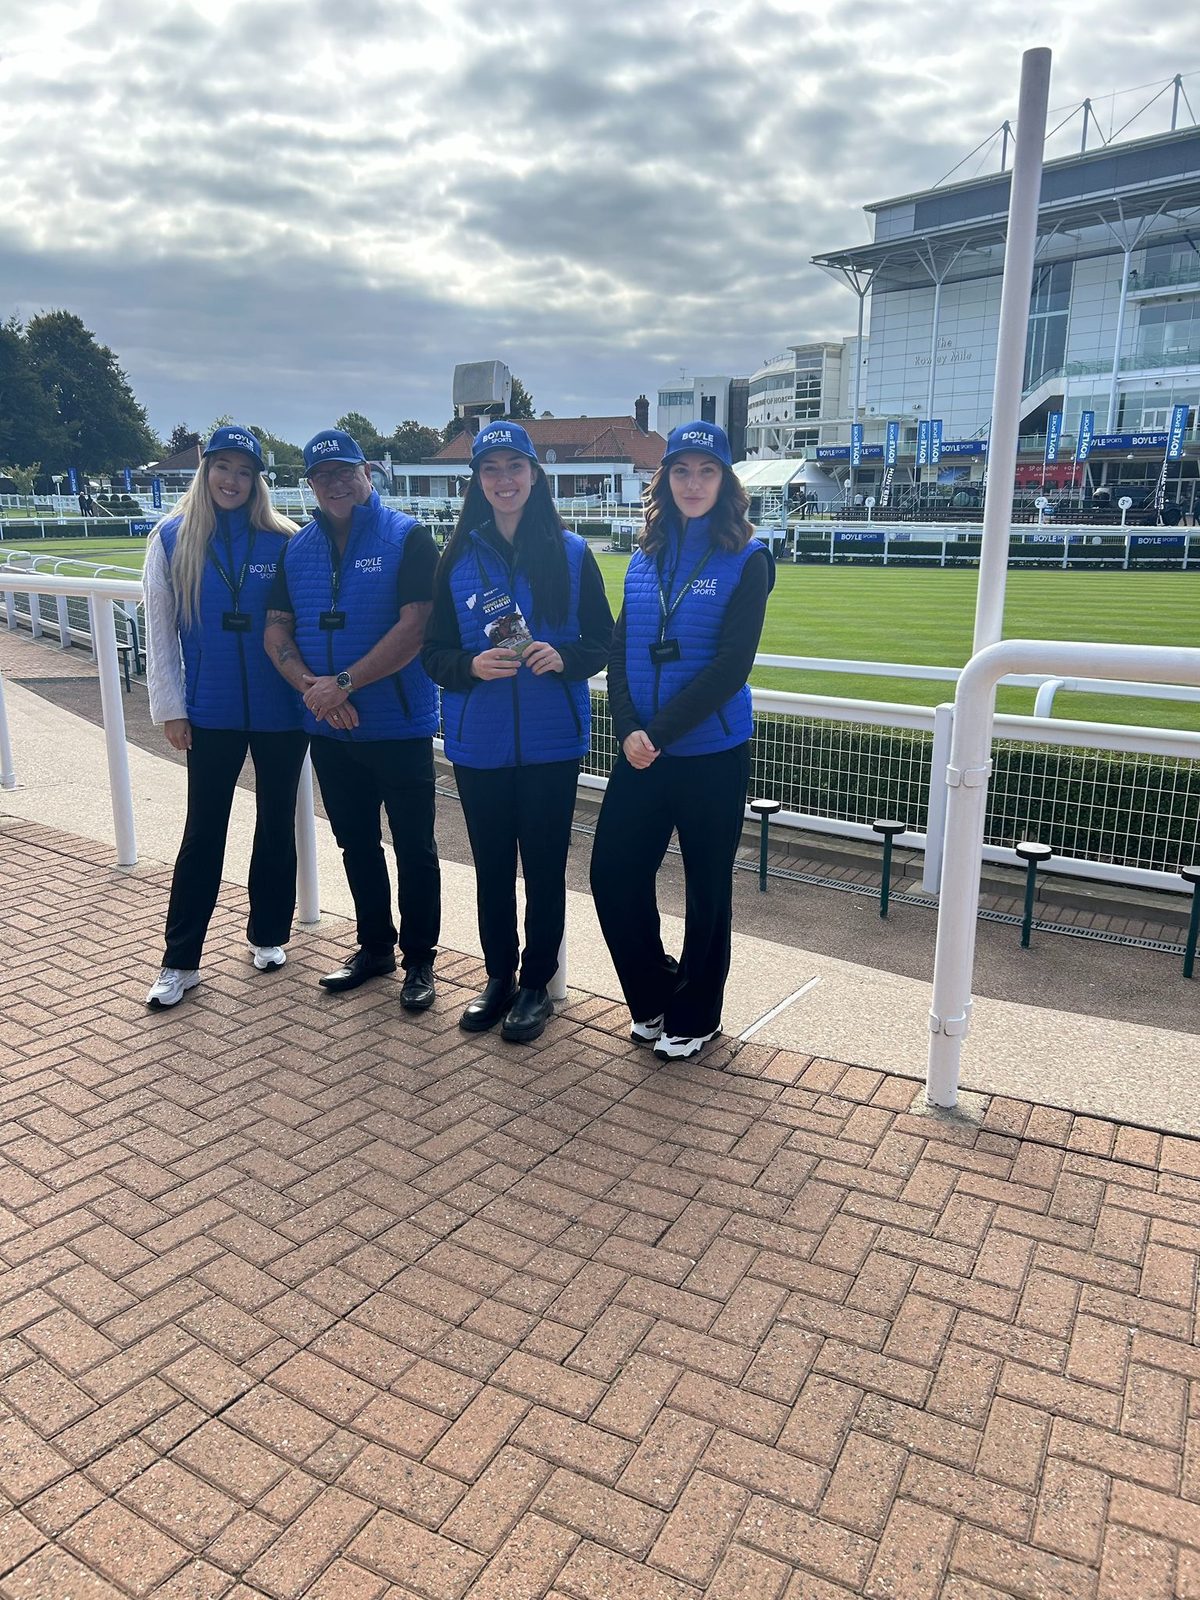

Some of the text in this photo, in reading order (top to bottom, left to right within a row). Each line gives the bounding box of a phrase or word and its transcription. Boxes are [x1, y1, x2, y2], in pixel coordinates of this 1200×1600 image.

[937, 337, 953, 348] The
[914, 349, 972, 366] Rowey Mile
[482, 430, 511, 443] BOYLE
[682, 431, 714, 442] BOYLE
[1170, 408, 1183, 457] BOYLE SPORTS
[228, 433, 254, 447] BOYLE
[692, 439, 714, 448] SPORTS
[1080, 432, 1090, 459] BOYLE
[1132, 437, 1157, 446] BOYLE
[312, 440, 339, 454] BOYLE
[320, 446, 340, 455] SPORTS
[919, 439, 927, 464] BOYLE
[932, 439, 940, 463] BOYLE
[941, 444, 960, 452] BOYLE
[1048, 432, 1057, 460] BOYLE
[819, 449, 835, 457] BOYLE
[888, 440, 896, 464] BOYLE
[841, 533, 863, 541] BOYLE
[1033, 535, 1057, 543] BOYLE
[1137, 537, 1161, 545] BOYLE
[354, 556, 383, 569] BOYLE
[249, 563, 277, 574] BOYLE
[260, 572, 277, 580] SPORT
[691, 578, 718, 589] OYLE
[692, 588, 717, 596] SPORTS
